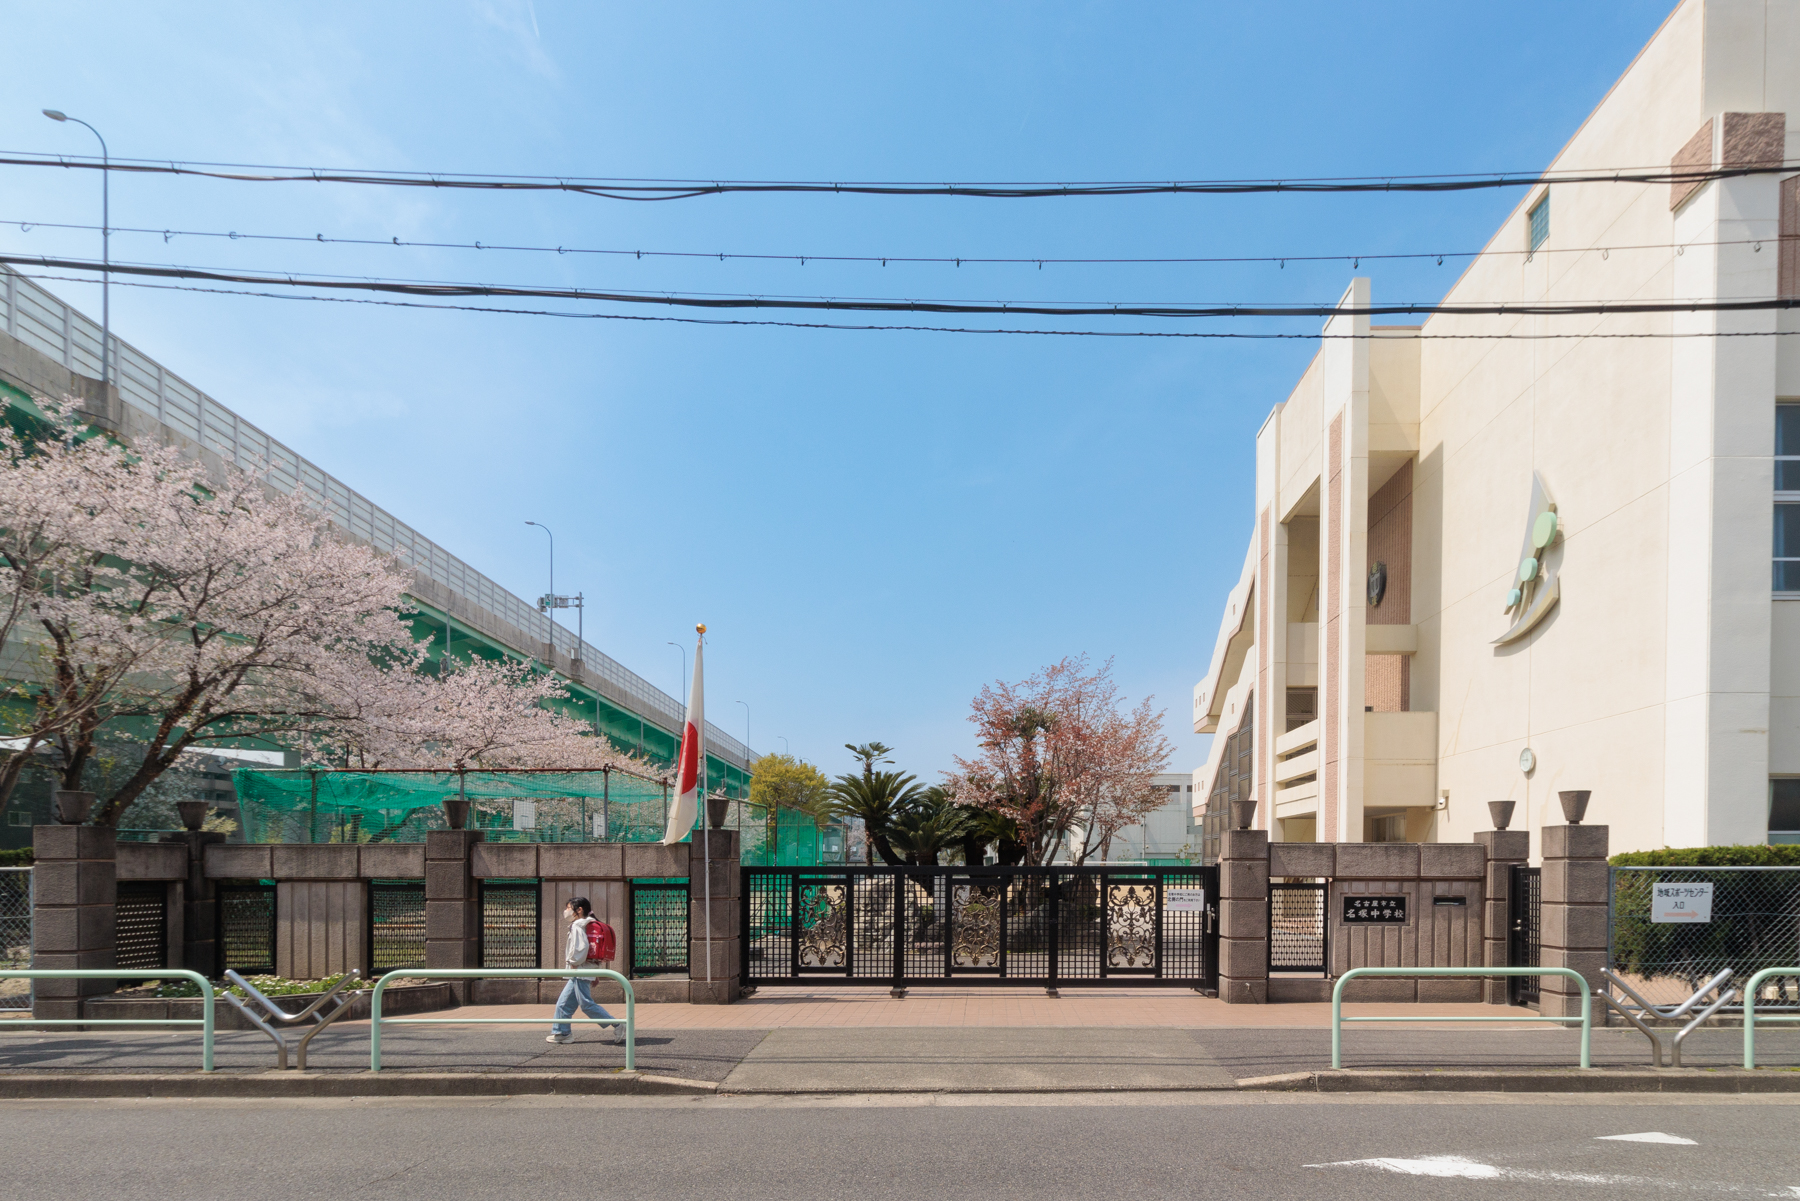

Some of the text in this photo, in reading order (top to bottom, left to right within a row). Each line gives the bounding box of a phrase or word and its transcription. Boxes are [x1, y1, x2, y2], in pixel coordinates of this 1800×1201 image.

[1656, 888, 1709, 898] 地域スポーツセンター
[1672, 901, 1685, 909] 入口
[1345, 909, 1404, 919] 名塚中学校
